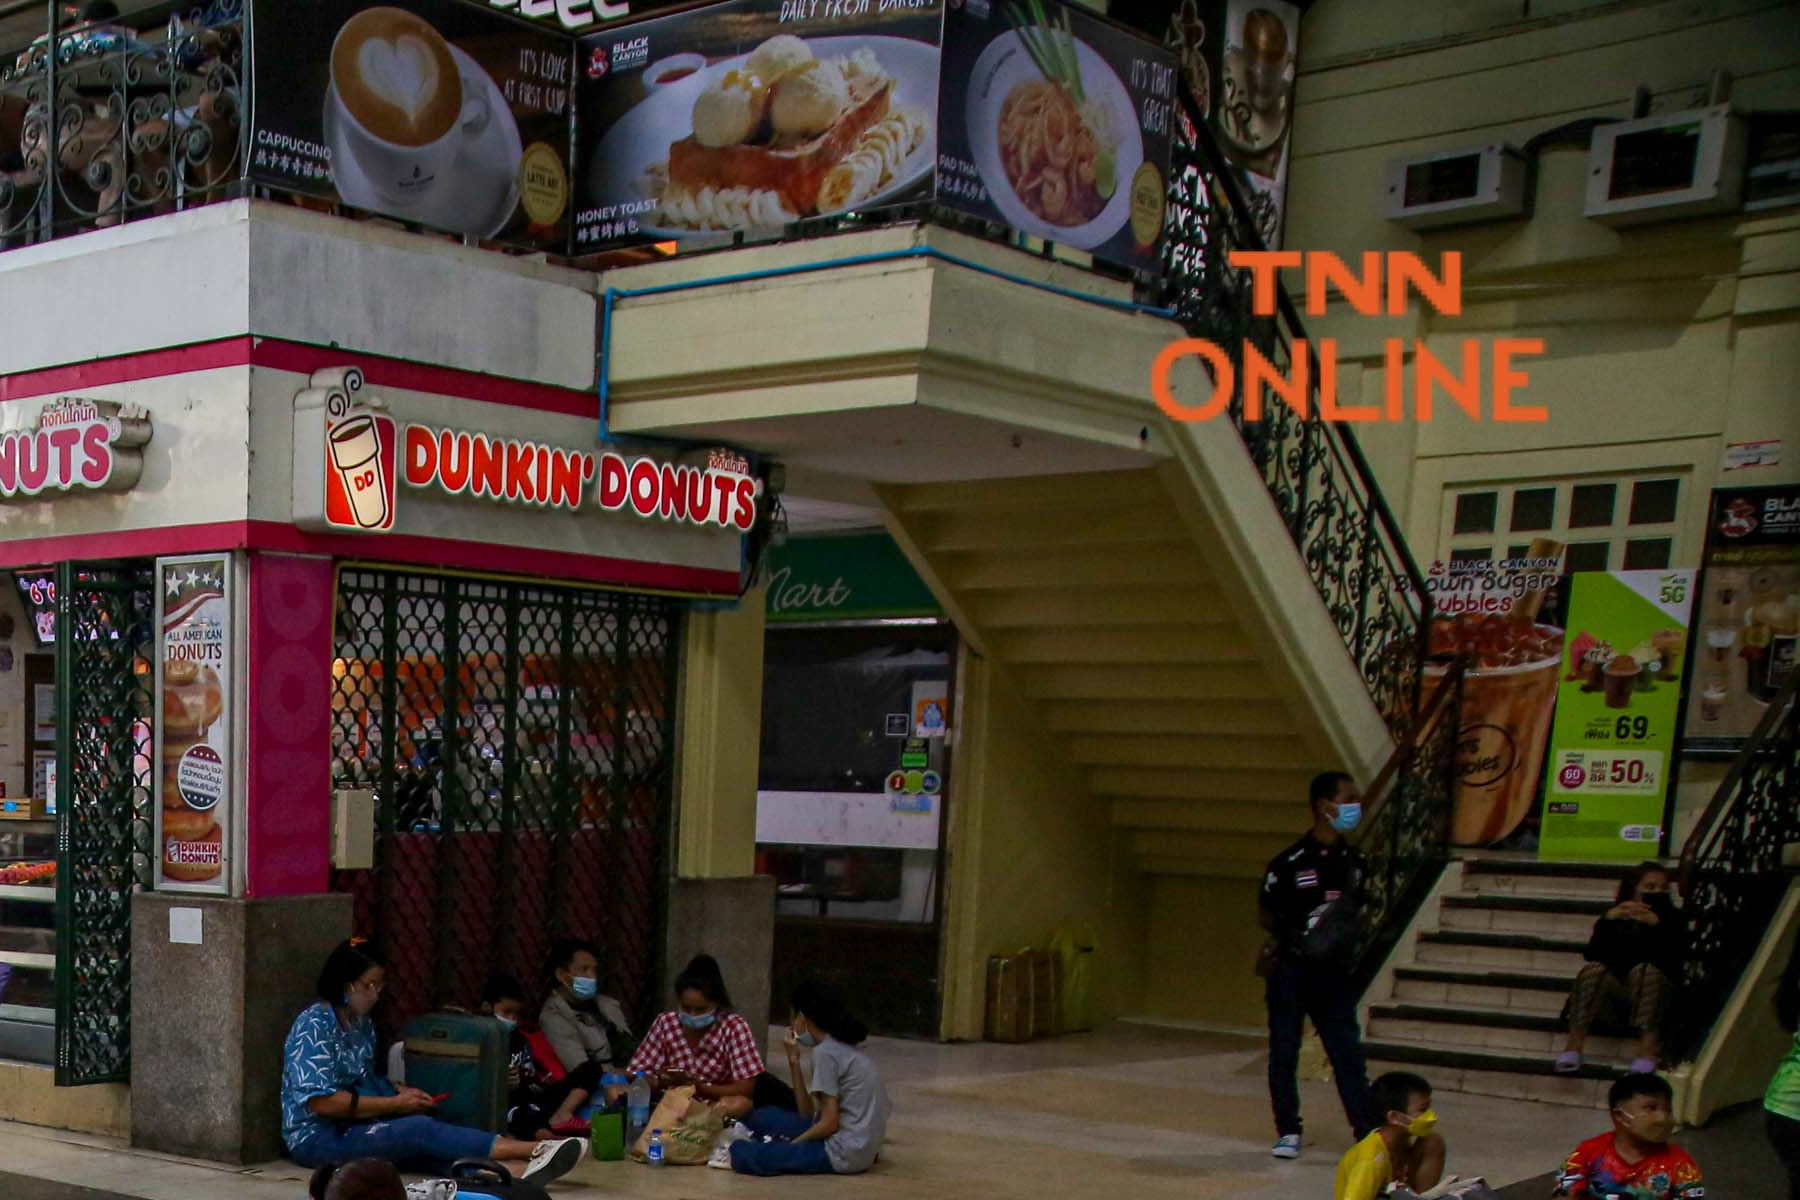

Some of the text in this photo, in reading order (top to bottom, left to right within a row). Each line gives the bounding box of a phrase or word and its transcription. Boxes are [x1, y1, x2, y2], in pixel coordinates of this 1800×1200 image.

[612, 36, 649, 54] BLACK
[612, 47, 649, 63] CANYON
[520, 47, 567, 83] IT'S LOVE
[1132, 57, 1173, 98] IT'S THAT
[504, 79, 567, 115] AT FIRST CUP
[1143, 98, 1170, 136] GREAT
[257, 129, 332, 161] CAPPUCCINO
[576, 199, 658, 225] HONEY TOAST
[354, 470, 374, 492] DD
[405, 424, 756, 530] DUNKIN' DONUTS
[1449, 558, 1560, 571] BLACK CANYON
[1482, 571, 1560, 599] Sugar
[1660, 585, 1686, 604] 5G
[1430, 592, 1513, 613] ubbles
[168, 628, 222, 641] ALL AMERICAN
[167, 642, 222, 661] DONUTS
[181, 841, 221, 854] DUNKIN'
[181, 852, 219, 864] DONUTS
